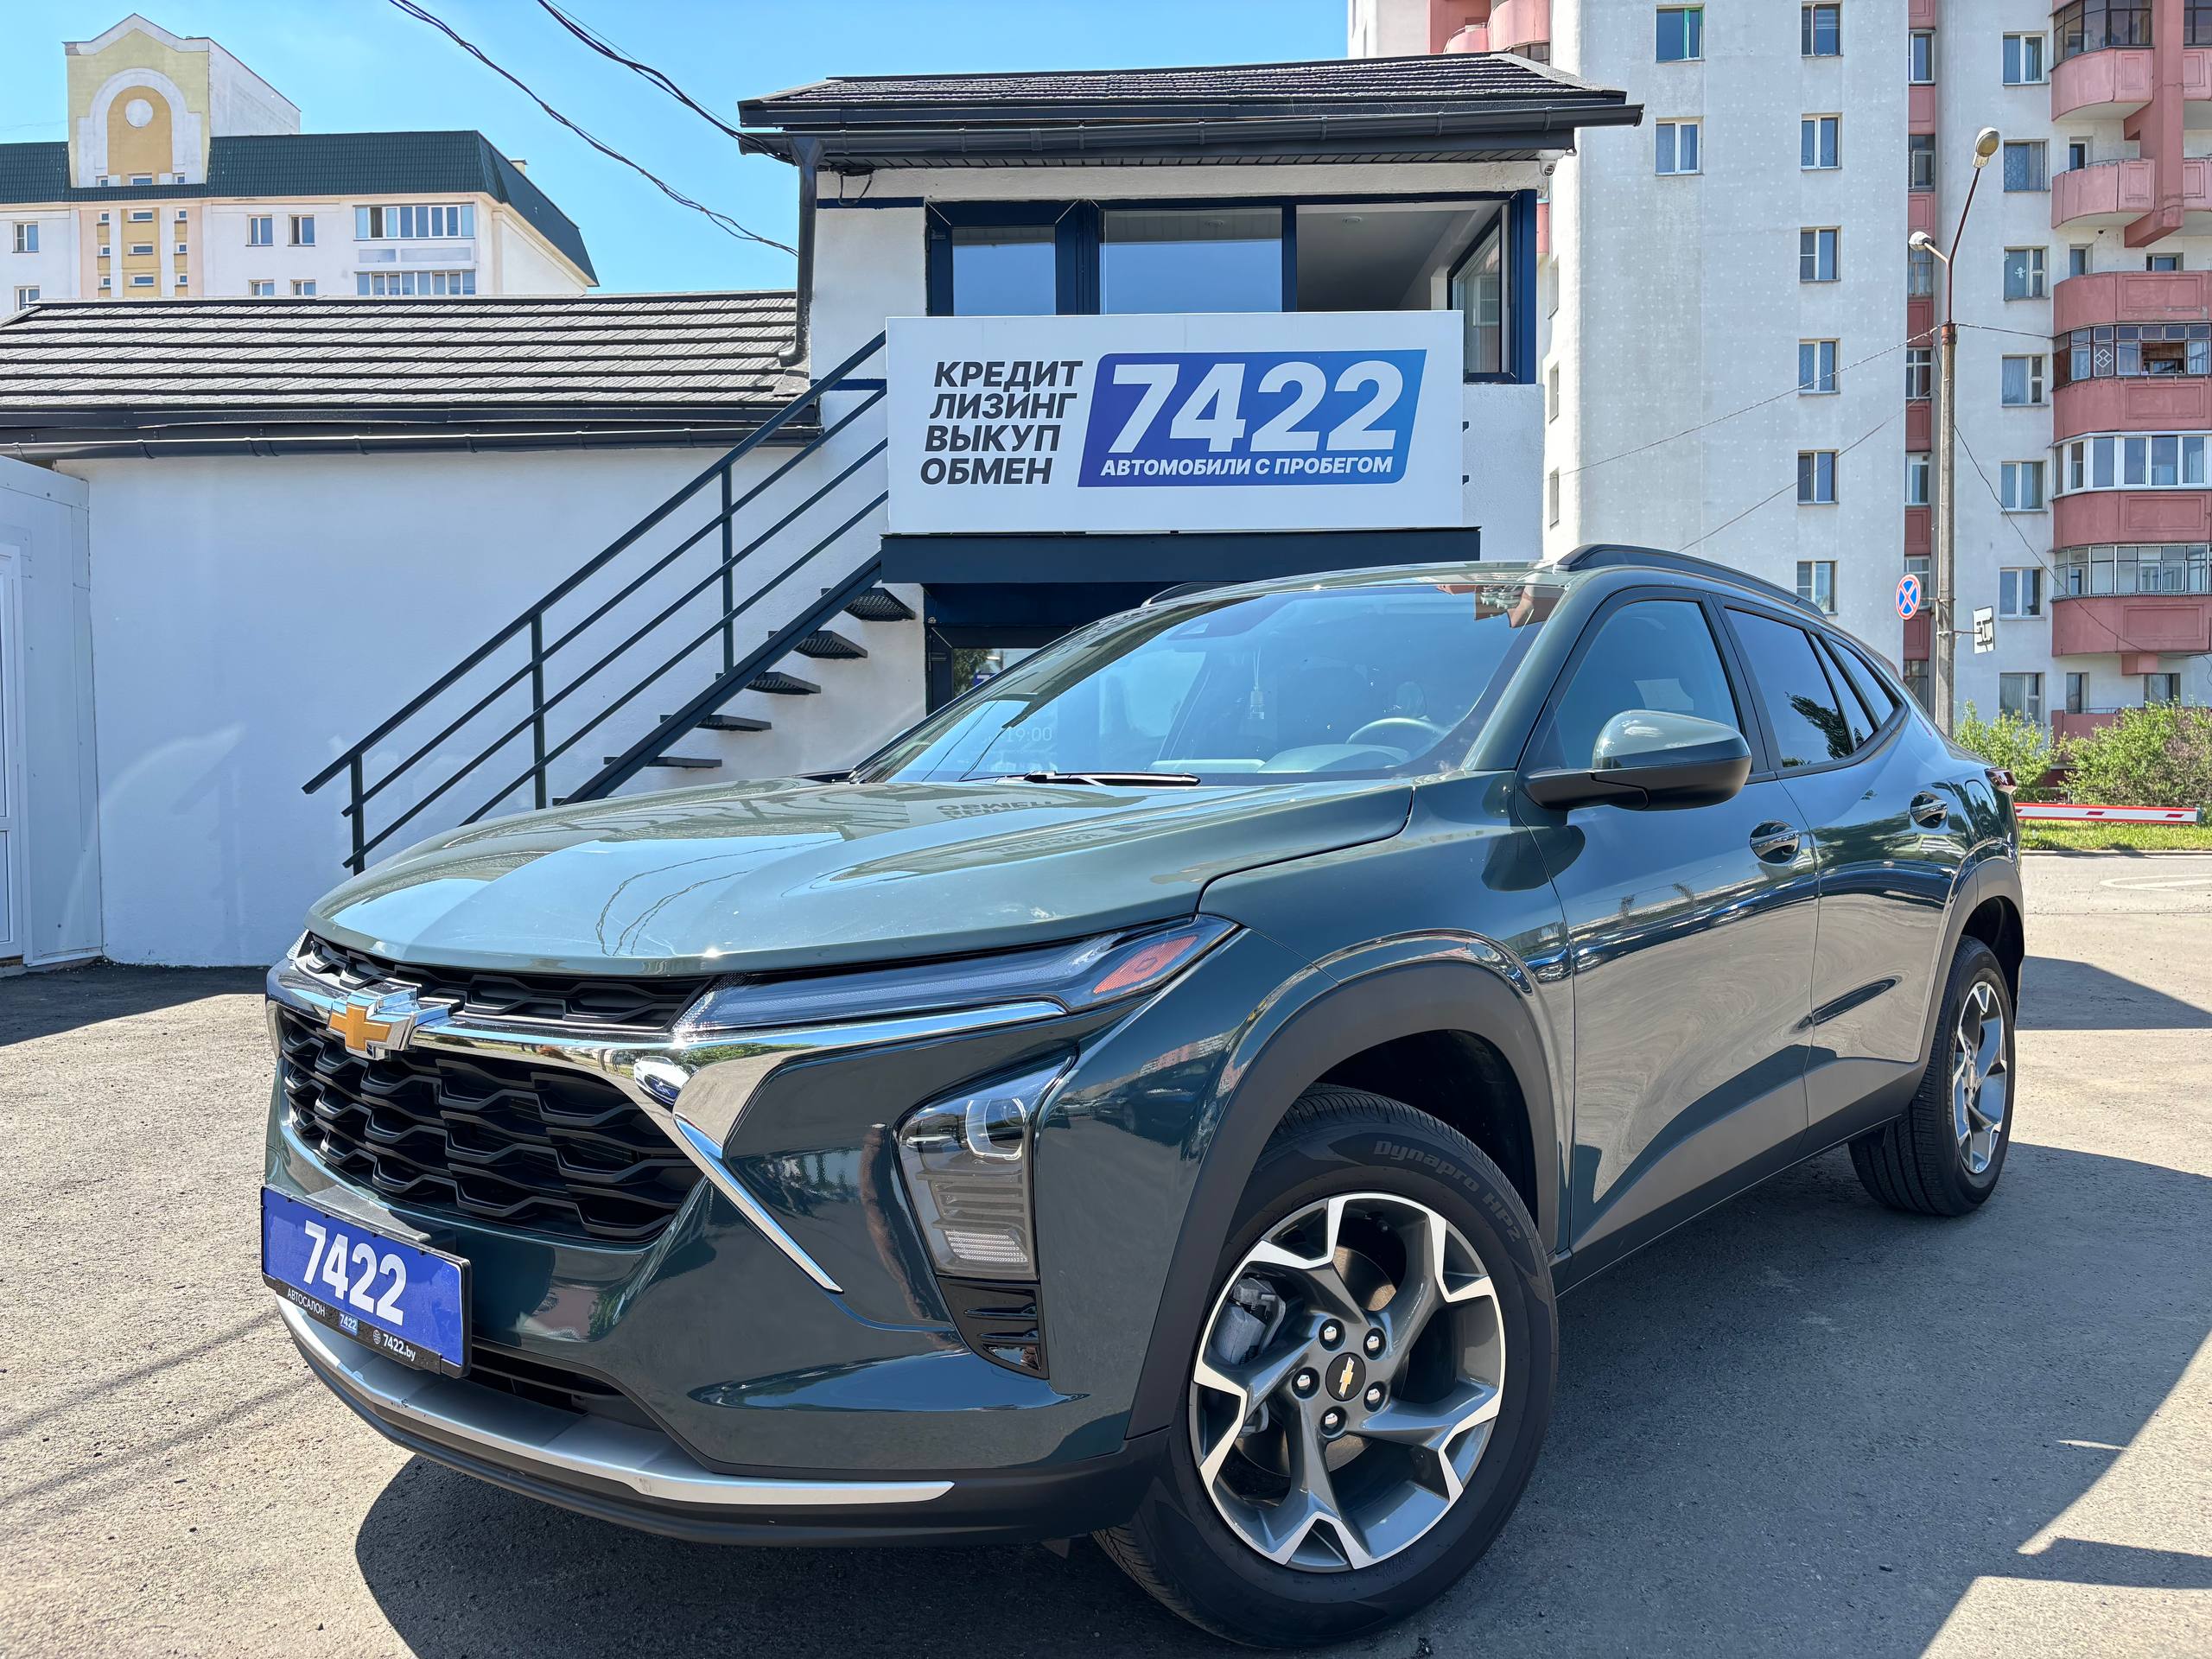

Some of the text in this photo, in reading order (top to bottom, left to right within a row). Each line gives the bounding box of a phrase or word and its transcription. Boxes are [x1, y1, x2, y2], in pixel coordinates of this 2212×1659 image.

[933, 360, 1084, 392] КРЕДИТ
[930, 392, 1078, 420] ЛИЗИНГ
[1107, 360, 1404, 454] 7422
[925, 423, 1061, 452] ВЫКУП
[919, 457, 1052, 486] ОБМЕН
[1100, 455, 1393, 477] АВТОМОБИЛИ С ПРОБЕГОМ
[1374, 1140, 1522, 1243] Dynapro HP2
[303, 1219, 406, 1326] 7422
[287, 1287, 326, 1317] АВТОСАЛОН
[340, 1313, 358, 1331] 7422
[383, 1333, 416, 1362] 7422.by
